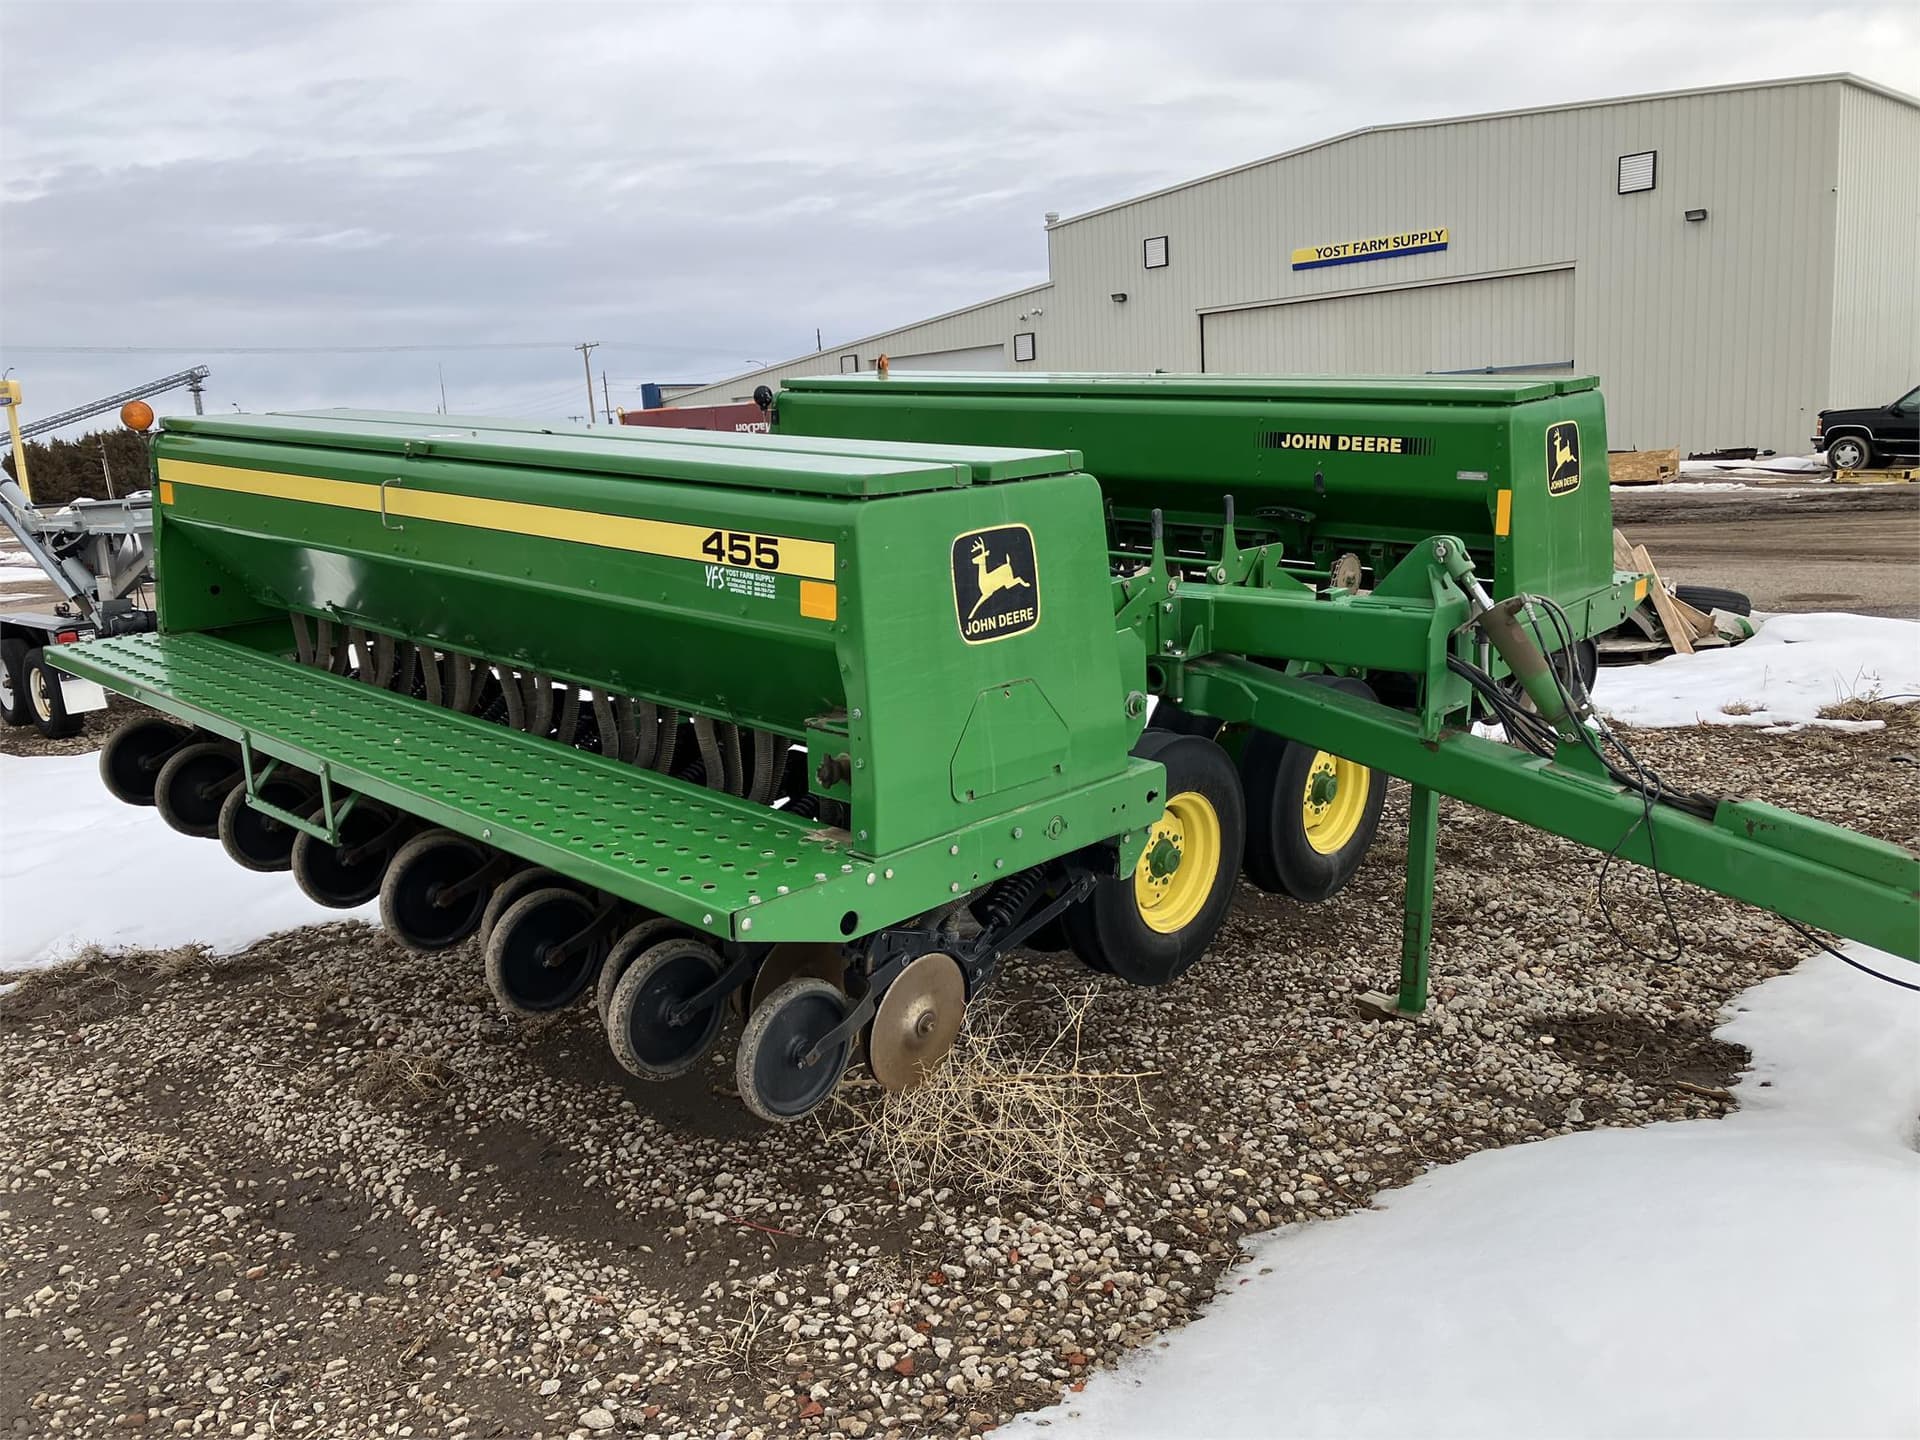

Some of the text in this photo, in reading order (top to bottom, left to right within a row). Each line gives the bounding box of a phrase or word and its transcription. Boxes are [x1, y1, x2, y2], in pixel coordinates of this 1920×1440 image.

[1315, 229, 1444, 259] YOST FARM SUPPLY
[1281, 433, 1402, 453] JOHN DEERE
[702, 531, 779, 570] 455
[705, 565, 725, 590] YFS
[725, 568, 739, 578] YOST
[740, 570, 754, 580] FARM
[755, 573, 776, 583] SUPPLY
[965, 607, 1034, 636] JOHN DEERE
